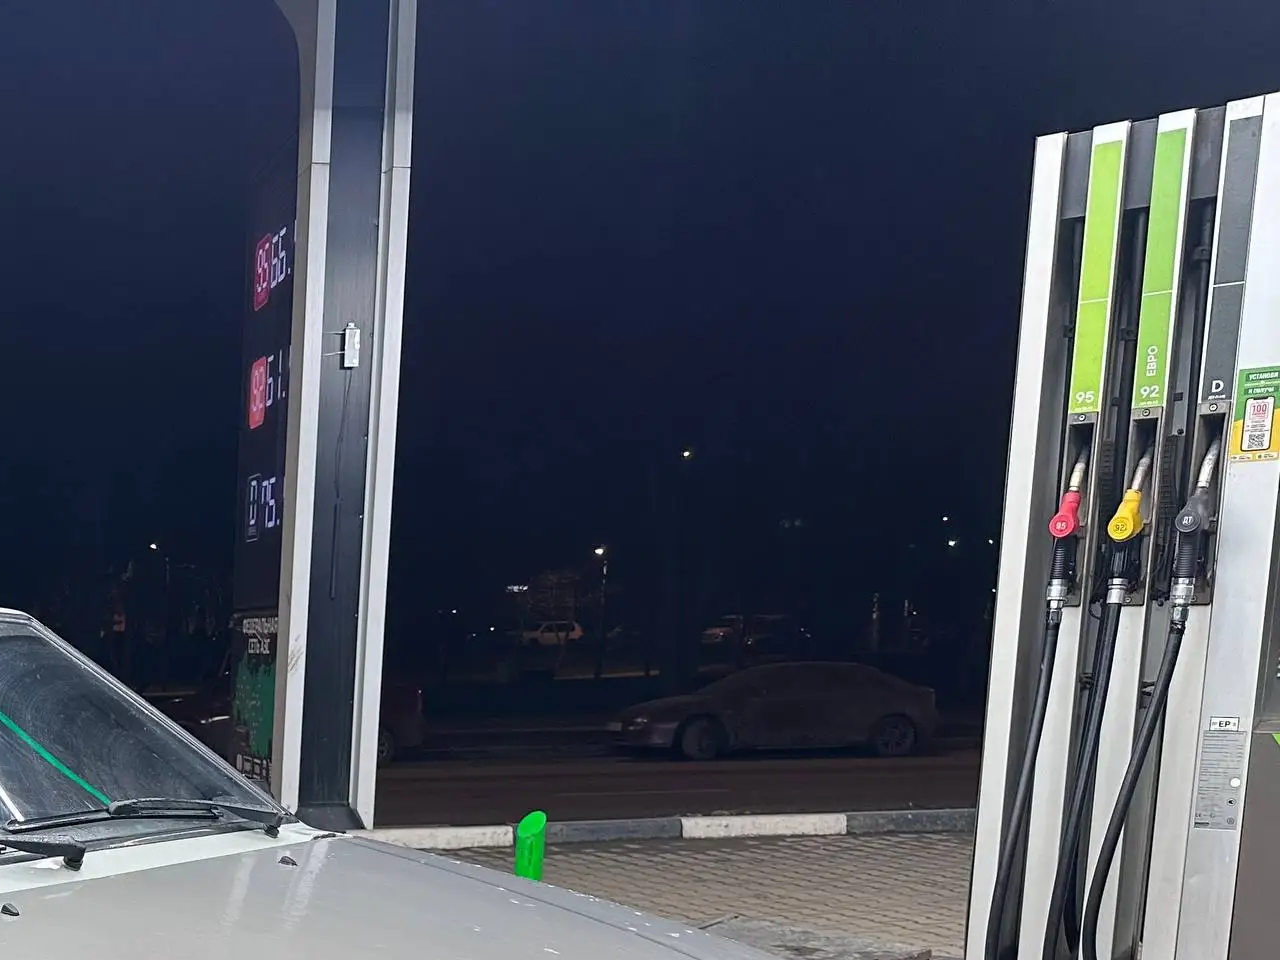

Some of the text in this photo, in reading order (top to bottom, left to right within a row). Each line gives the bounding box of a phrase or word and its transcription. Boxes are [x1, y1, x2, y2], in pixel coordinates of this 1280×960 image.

[1145, 345, 1159, 377] ЕВРО
[1139, 384, 1160, 399] 92
[1211, 379, 1225, 393] D
[1075, 390, 1096, 404] 95
[1252, 403, 1268, 414] 100
[1055, 521, 1067, 530] 95
[1182, 516, 1193, 526] ДТ
[1115, 524, 1127, 532] 92
